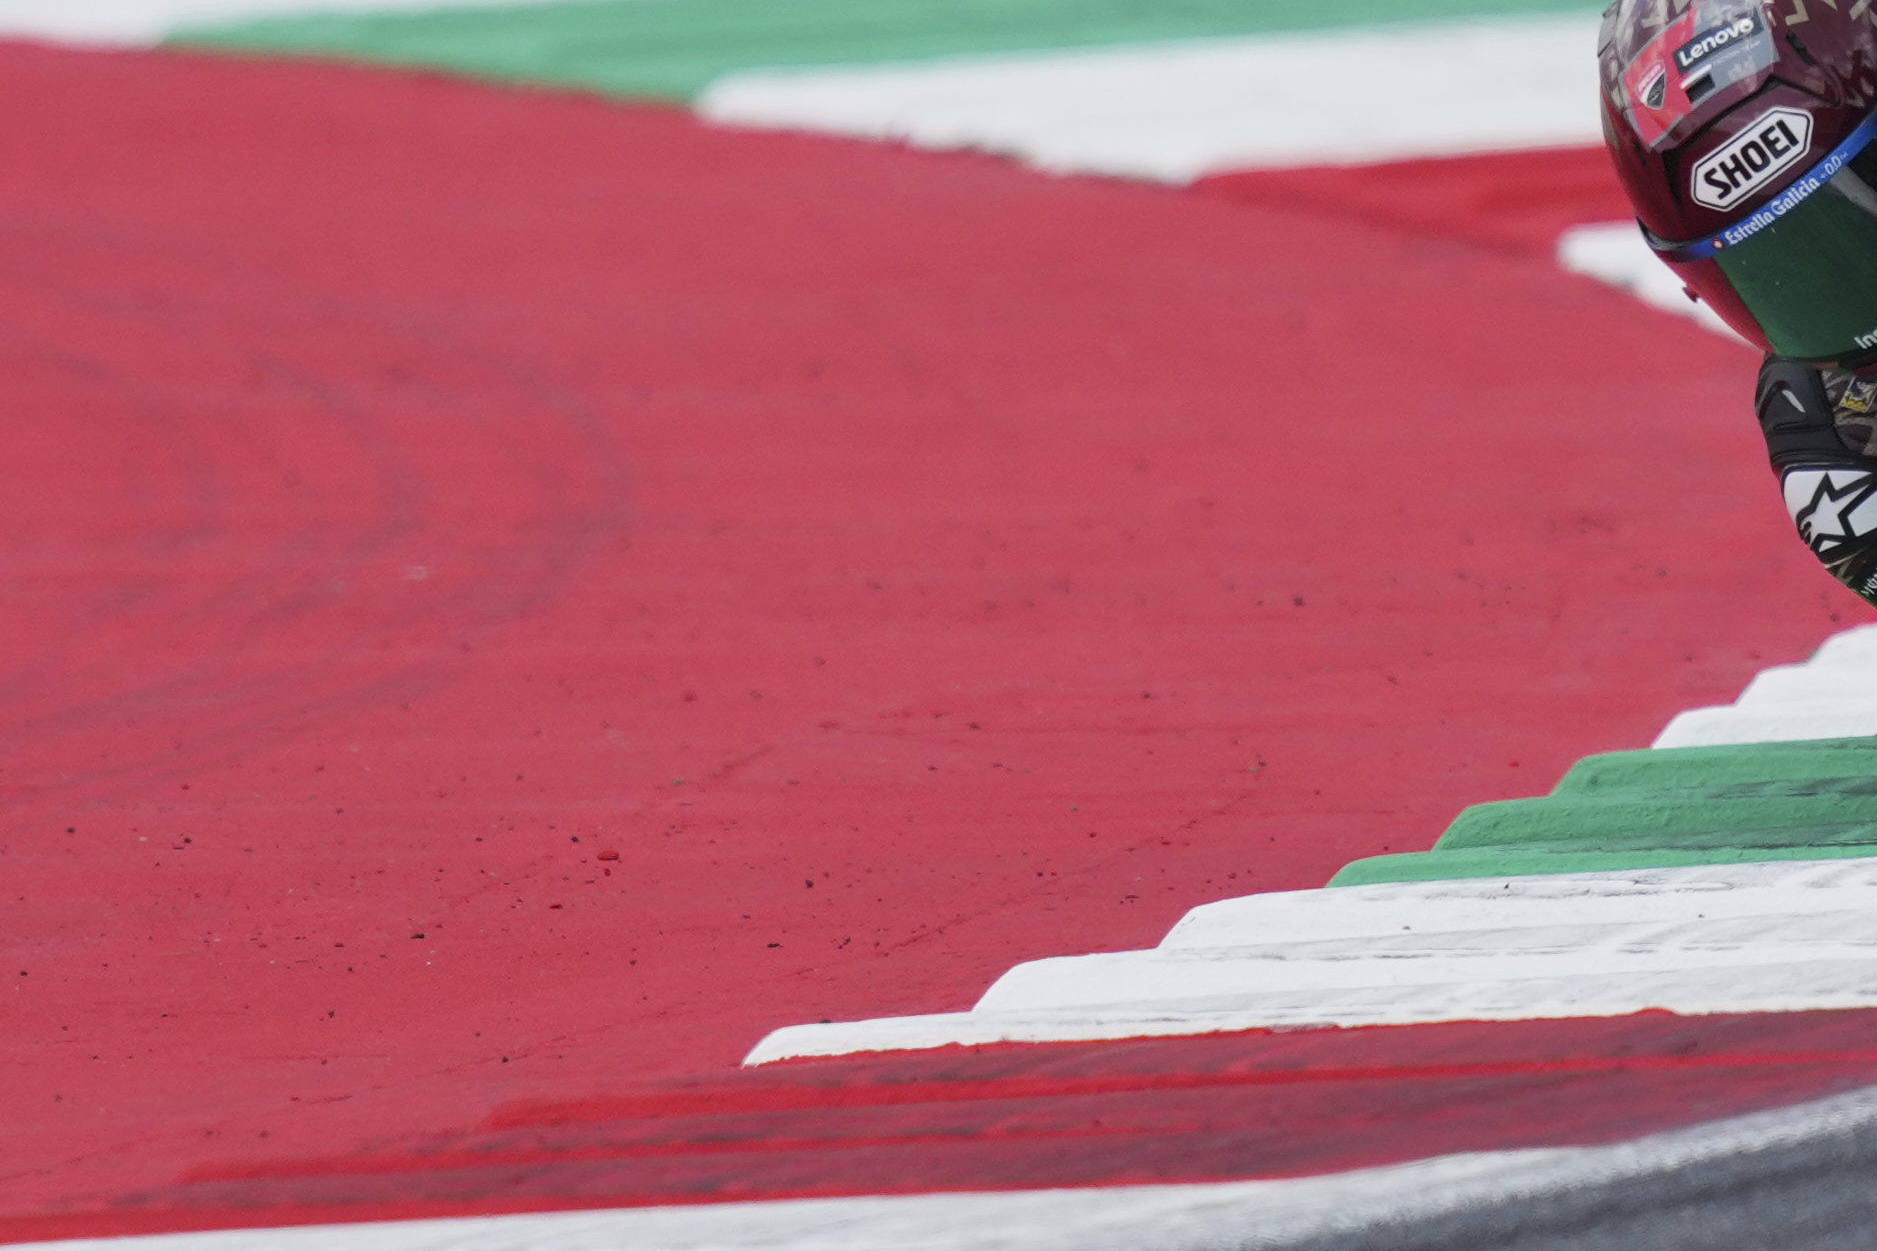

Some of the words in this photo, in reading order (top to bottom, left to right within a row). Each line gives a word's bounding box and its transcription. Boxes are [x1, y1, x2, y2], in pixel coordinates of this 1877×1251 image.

[1678, 18, 1755, 67] Lenovo
[1703, 118, 1800, 201] SHOEI
[1725, 213, 1775, 246] Estrella
[1771, 176, 1821, 216] Galicia
